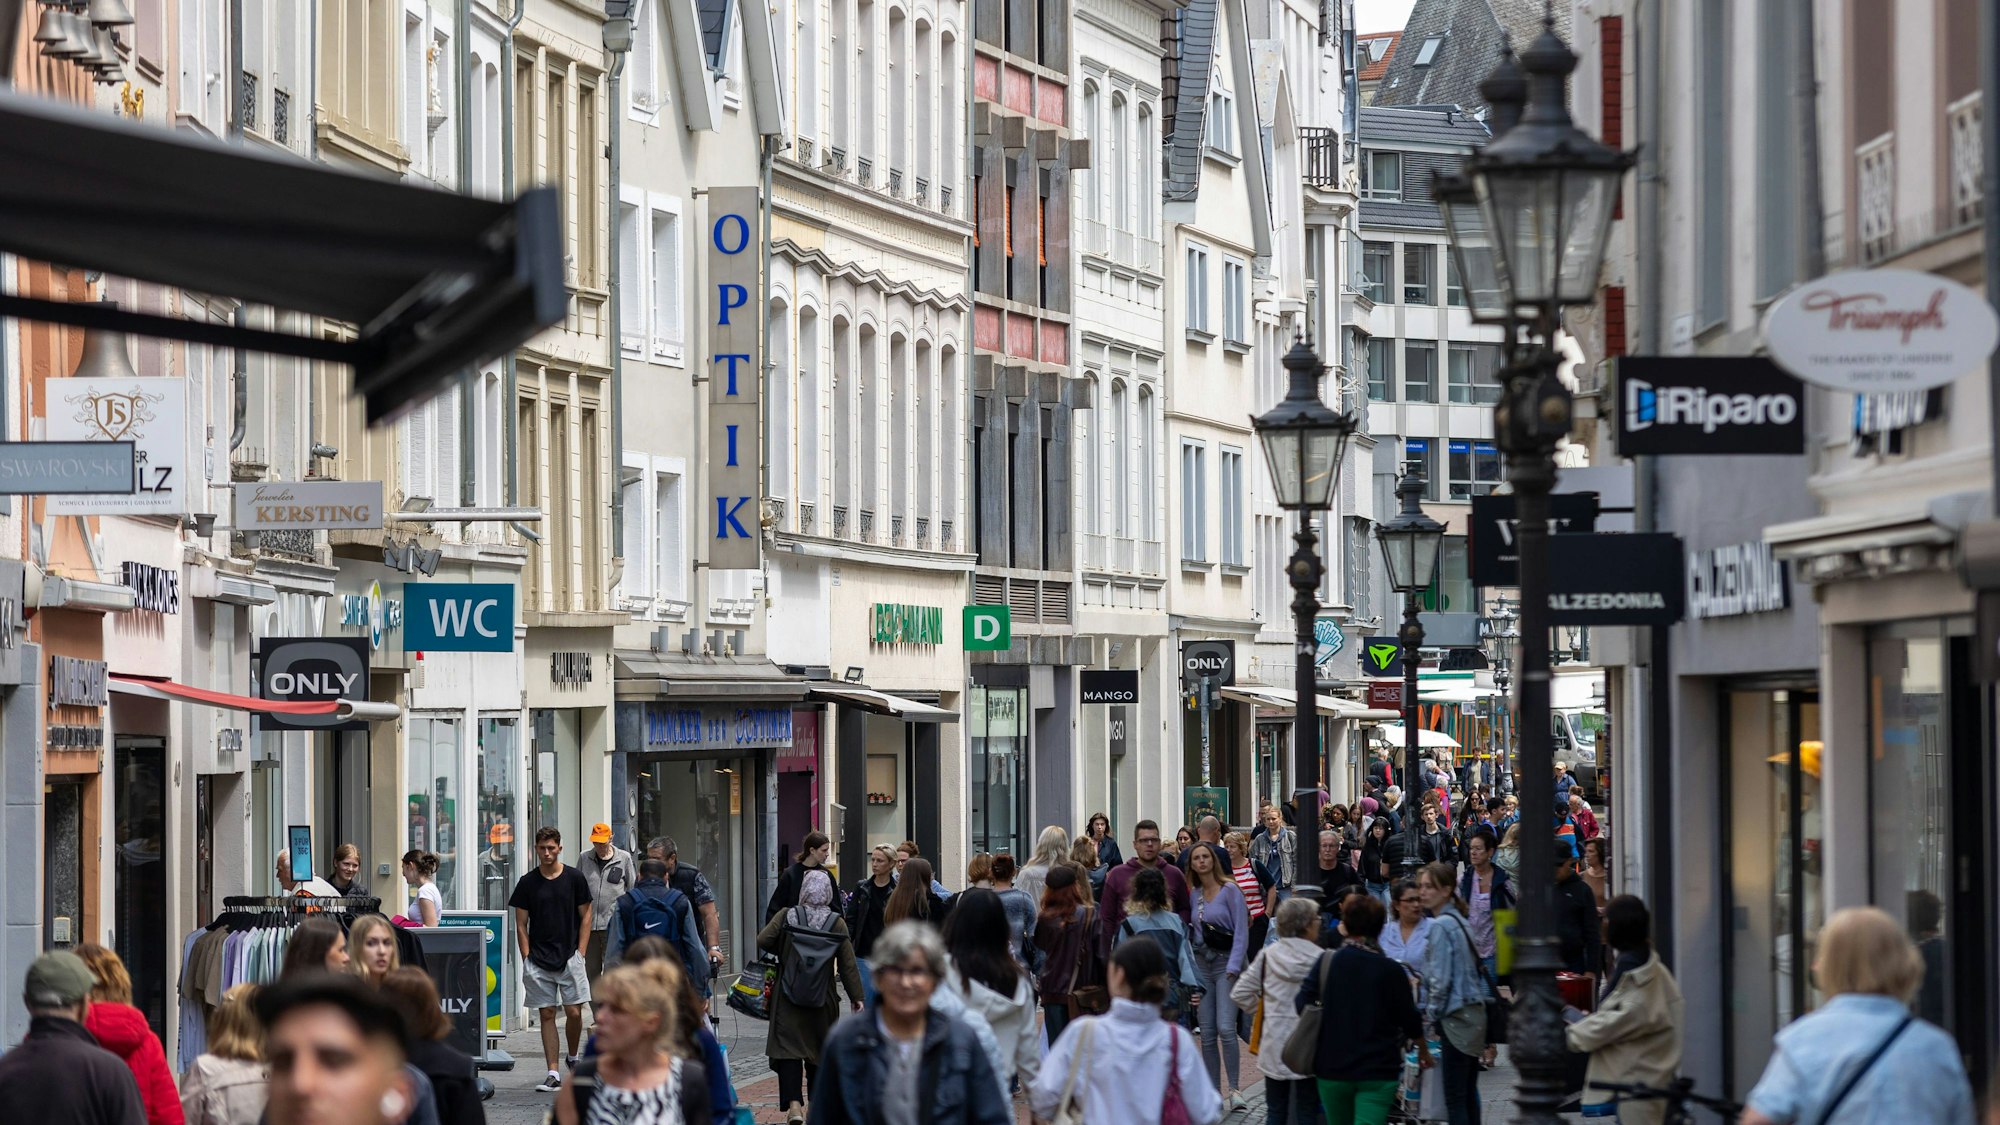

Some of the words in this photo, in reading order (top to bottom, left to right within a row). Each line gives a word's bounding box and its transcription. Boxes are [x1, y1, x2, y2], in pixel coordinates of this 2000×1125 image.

[1802, 288, 1948, 344] Triumph
[713, 214, 752, 539] OPTIK
[1656, 387, 1797, 433] iRiparo
[1, 457, 126, 479] SWAROVSKI
[248, 486, 294, 505] Juwelier
[256, 504, 370, 522] KERSTING
[1548, 593, 1665, 610] ALZEDONIA
[428, 598, 498, 638] WC
[872, 602, 943, 645] DEICHMANN
[973, 614, 1000, 641] D
[1187, 657, 1228, 670] ONLY
[270, 673, 358, 695] ONLY
[1084, 690, 1133, 701] MANGO
[1110, 720, 1124, 740] NGO
[439, 998, 472, 1013] NLY
